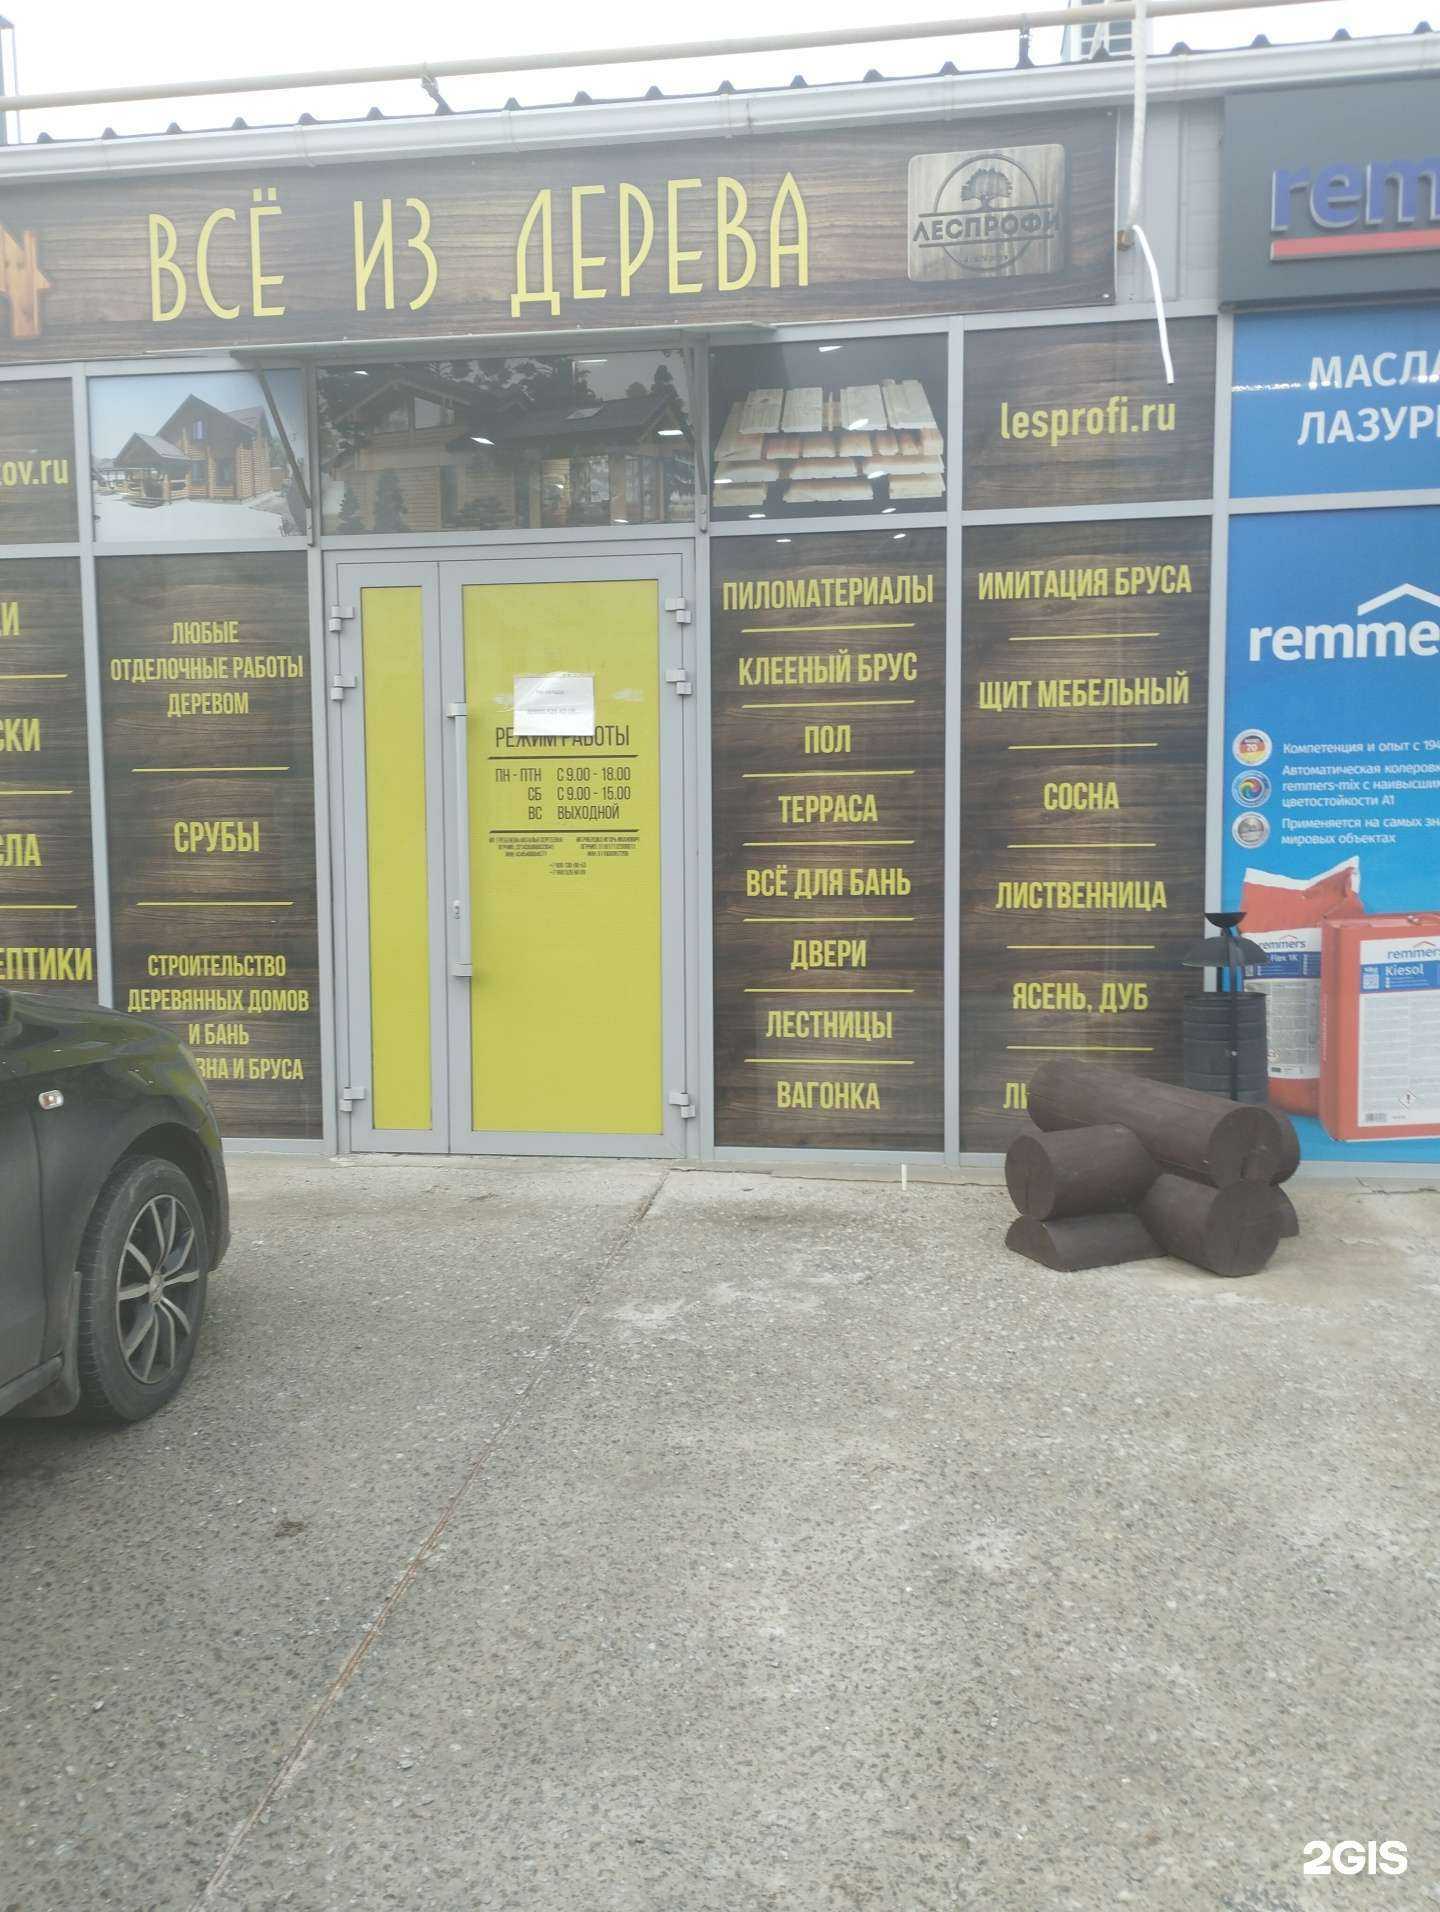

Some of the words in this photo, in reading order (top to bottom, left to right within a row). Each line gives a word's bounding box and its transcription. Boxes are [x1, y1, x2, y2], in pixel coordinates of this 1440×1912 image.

[913, 212, 1060, 241] ЛЕСПРОФИ
[147, 187, 287, 323] ВСЁ
[352, 196, 440, 313] ИЗ
[509, 170, 810, 319] ДЕРЕВА
[1000, 398, 1176, 447] lesprofi.ru
[1297, 404, 1440, 445] ЛАЗУР
[0, 458, 69, 487] ov.ru
[722, 574, 934, 611] ПИЛОМАТЕРИАЛЫ
[978, 567, 1108, 601] ИМИТАЦИЯ
[1114, 564, 1192, 596] БРУСА
[171, 621, 240, 645] ЛЮБЫЕ
[110, 656, 229, 683] ОТДЕЛОЧНЫЕ
[233, 655, 304, 679] РАБОТЫ
[738, 649, 852, 686] КЛЕЕНЫЙ
[857, 652, 918, 682] БРУС
[167, 692, 249, 718] ДЕРЕВОМ
[979, 680, 1032, 712] ЩИТ
[1037, 670, 1190, 709] МЕБЕЛЬНЫЙ
[804, 725, 851, 754] ПОЛ
[1283, 742, 1364, 754] Компетенция
[1367, 743, 1375, 752] и
[1379, 742, 1410, 752] опыт
[1413, 742, 1420, 751] с
[495, 769, 510, 782] ПН
[520, 769, 542, 782] ПТН
[567, 768, 590, 781] 9.00
[602, 767, 631, 781] 18.00
[1282, 764, 1381, 776] Автоматическая
[528, 787, 542, 801] СБ
[567, 787, 590, 801] 9.00
[602, 786, 631, 800] 15.00
[1043, 782, 1119, 811] СОСНА
[1282, 779, 1360, 791] remmers-mix
[1362, 781, 1370, 790] с
[528, 807, 542, 820] ВС
[557, 803, 619, 821] ВЫХОДНОЙ
[778, 794, 878, 823] ТЕРРАСА
[1282, 795, 1378, 808] цветостойкости
[173, 821, 260, 852] СРУБЫ
[1282, 819, 1361, 831] Применяется
[1365, 820, 1379, 829] на
[1384, 819, 1421, 828] самых
[1281, 834, 1335, 847] мировых
[1339, 833, 1396, 843] объектах
[746, 865, 788, 897] ВСЁ
[794, 869, 844, 899] ДЛЯ
[849, 869, 911, 896] БАНЬ
[995, 881, 1168, 910] ЛИСТВЕННИЦА
[147, 953, 287, 977] СТРОИТЕЛЬСТВО
[790, 940, 867, 970] ДВЕРИ
[1385, 963, 1424, 976] Kiesol
[127, 990, 244, 1013] ДЕРЕВЯННЫХ
[248, 988, 309, 1013] ДОМОВ
[1012, 983, 1093, 1012] ЯСЕНЬ,
[1099, 983, 1149, 1013] ДУБ
[188, 1024, 200, 1044] И
[205, 1024, 249, 1045] БАНЬ
[766, 1010, 893, 1042] ЛЕСТНИЦЫ
[233, 1058, 245, 1079] И
[249, 1058, 304, 1079] БРУСА
[777, 1081, 880, 1110] ВАГОНКА
